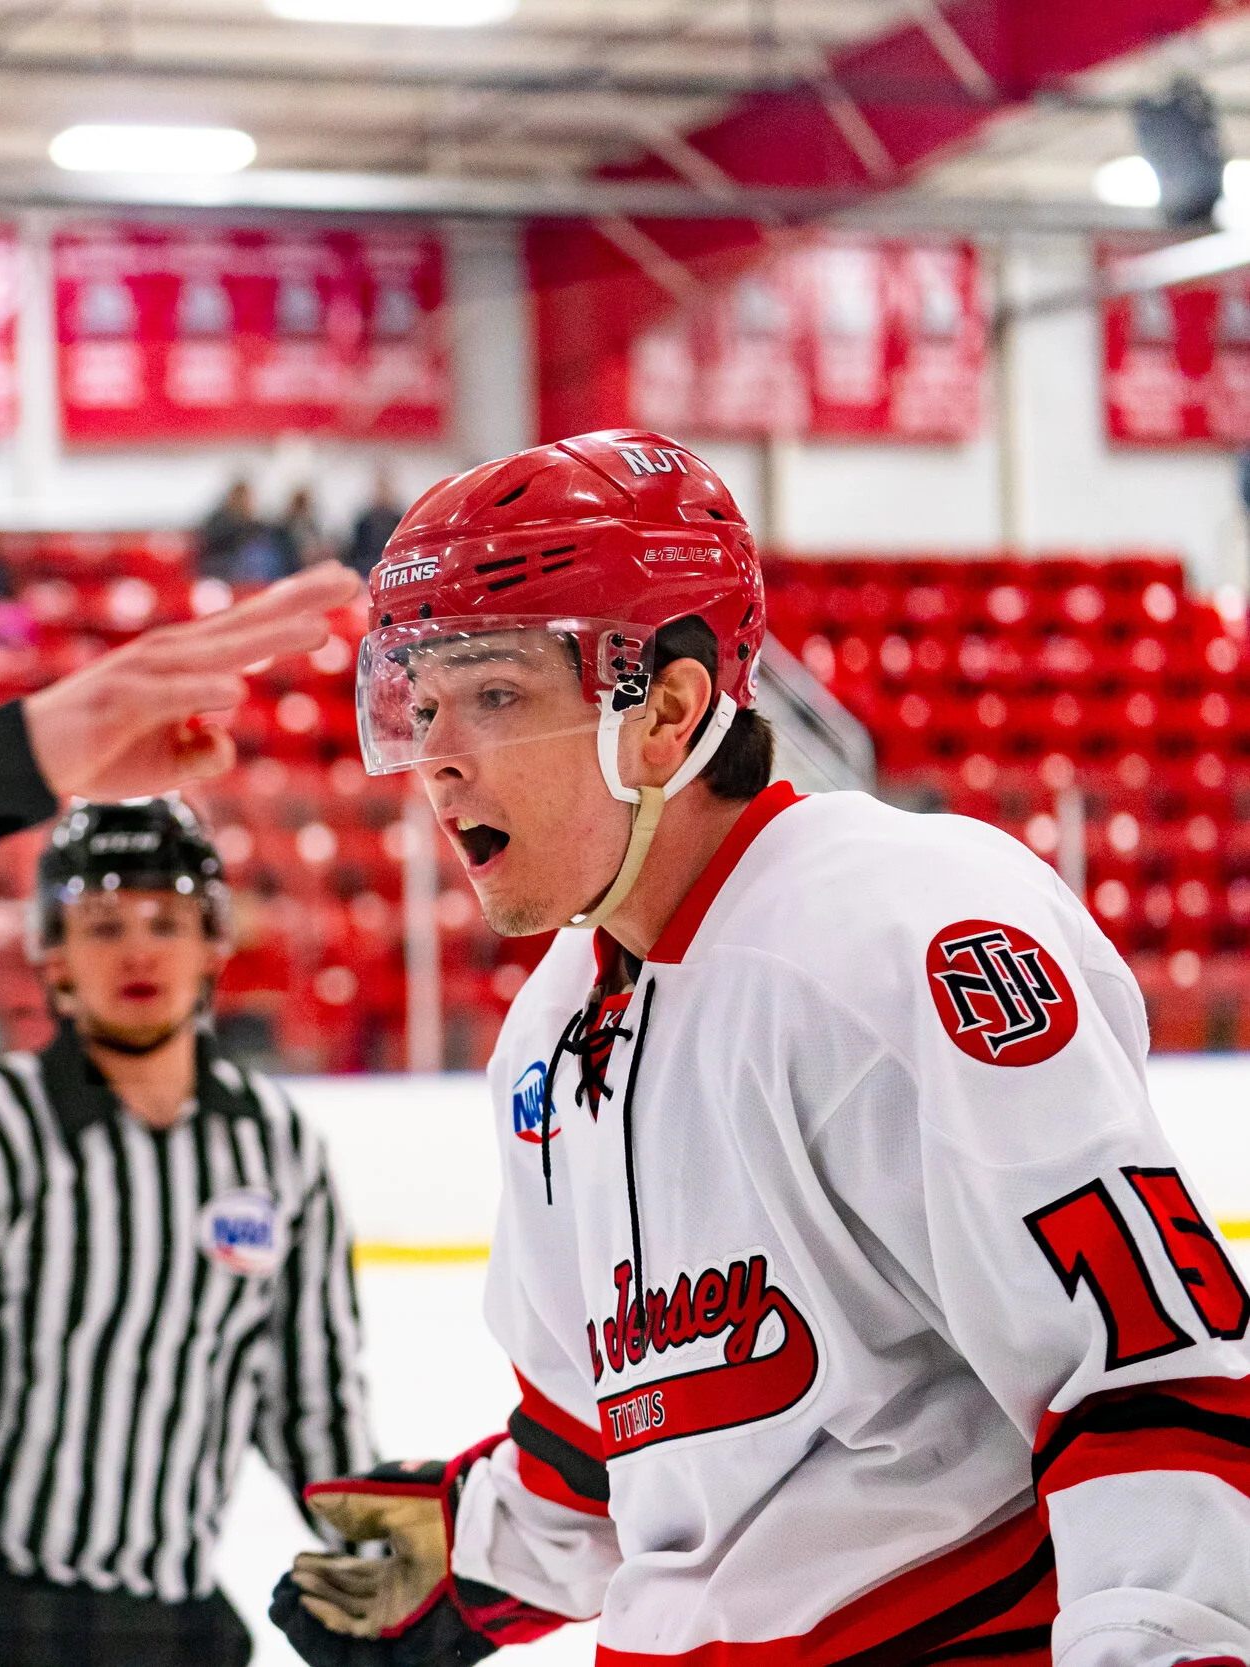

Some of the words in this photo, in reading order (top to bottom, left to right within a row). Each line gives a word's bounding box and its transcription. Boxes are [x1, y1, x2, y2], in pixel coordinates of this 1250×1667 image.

[618, 448, 689, 476] NJT
[379, 555, 439, 591] TITANS
[1023, 1166, 1250, 1371] 15
